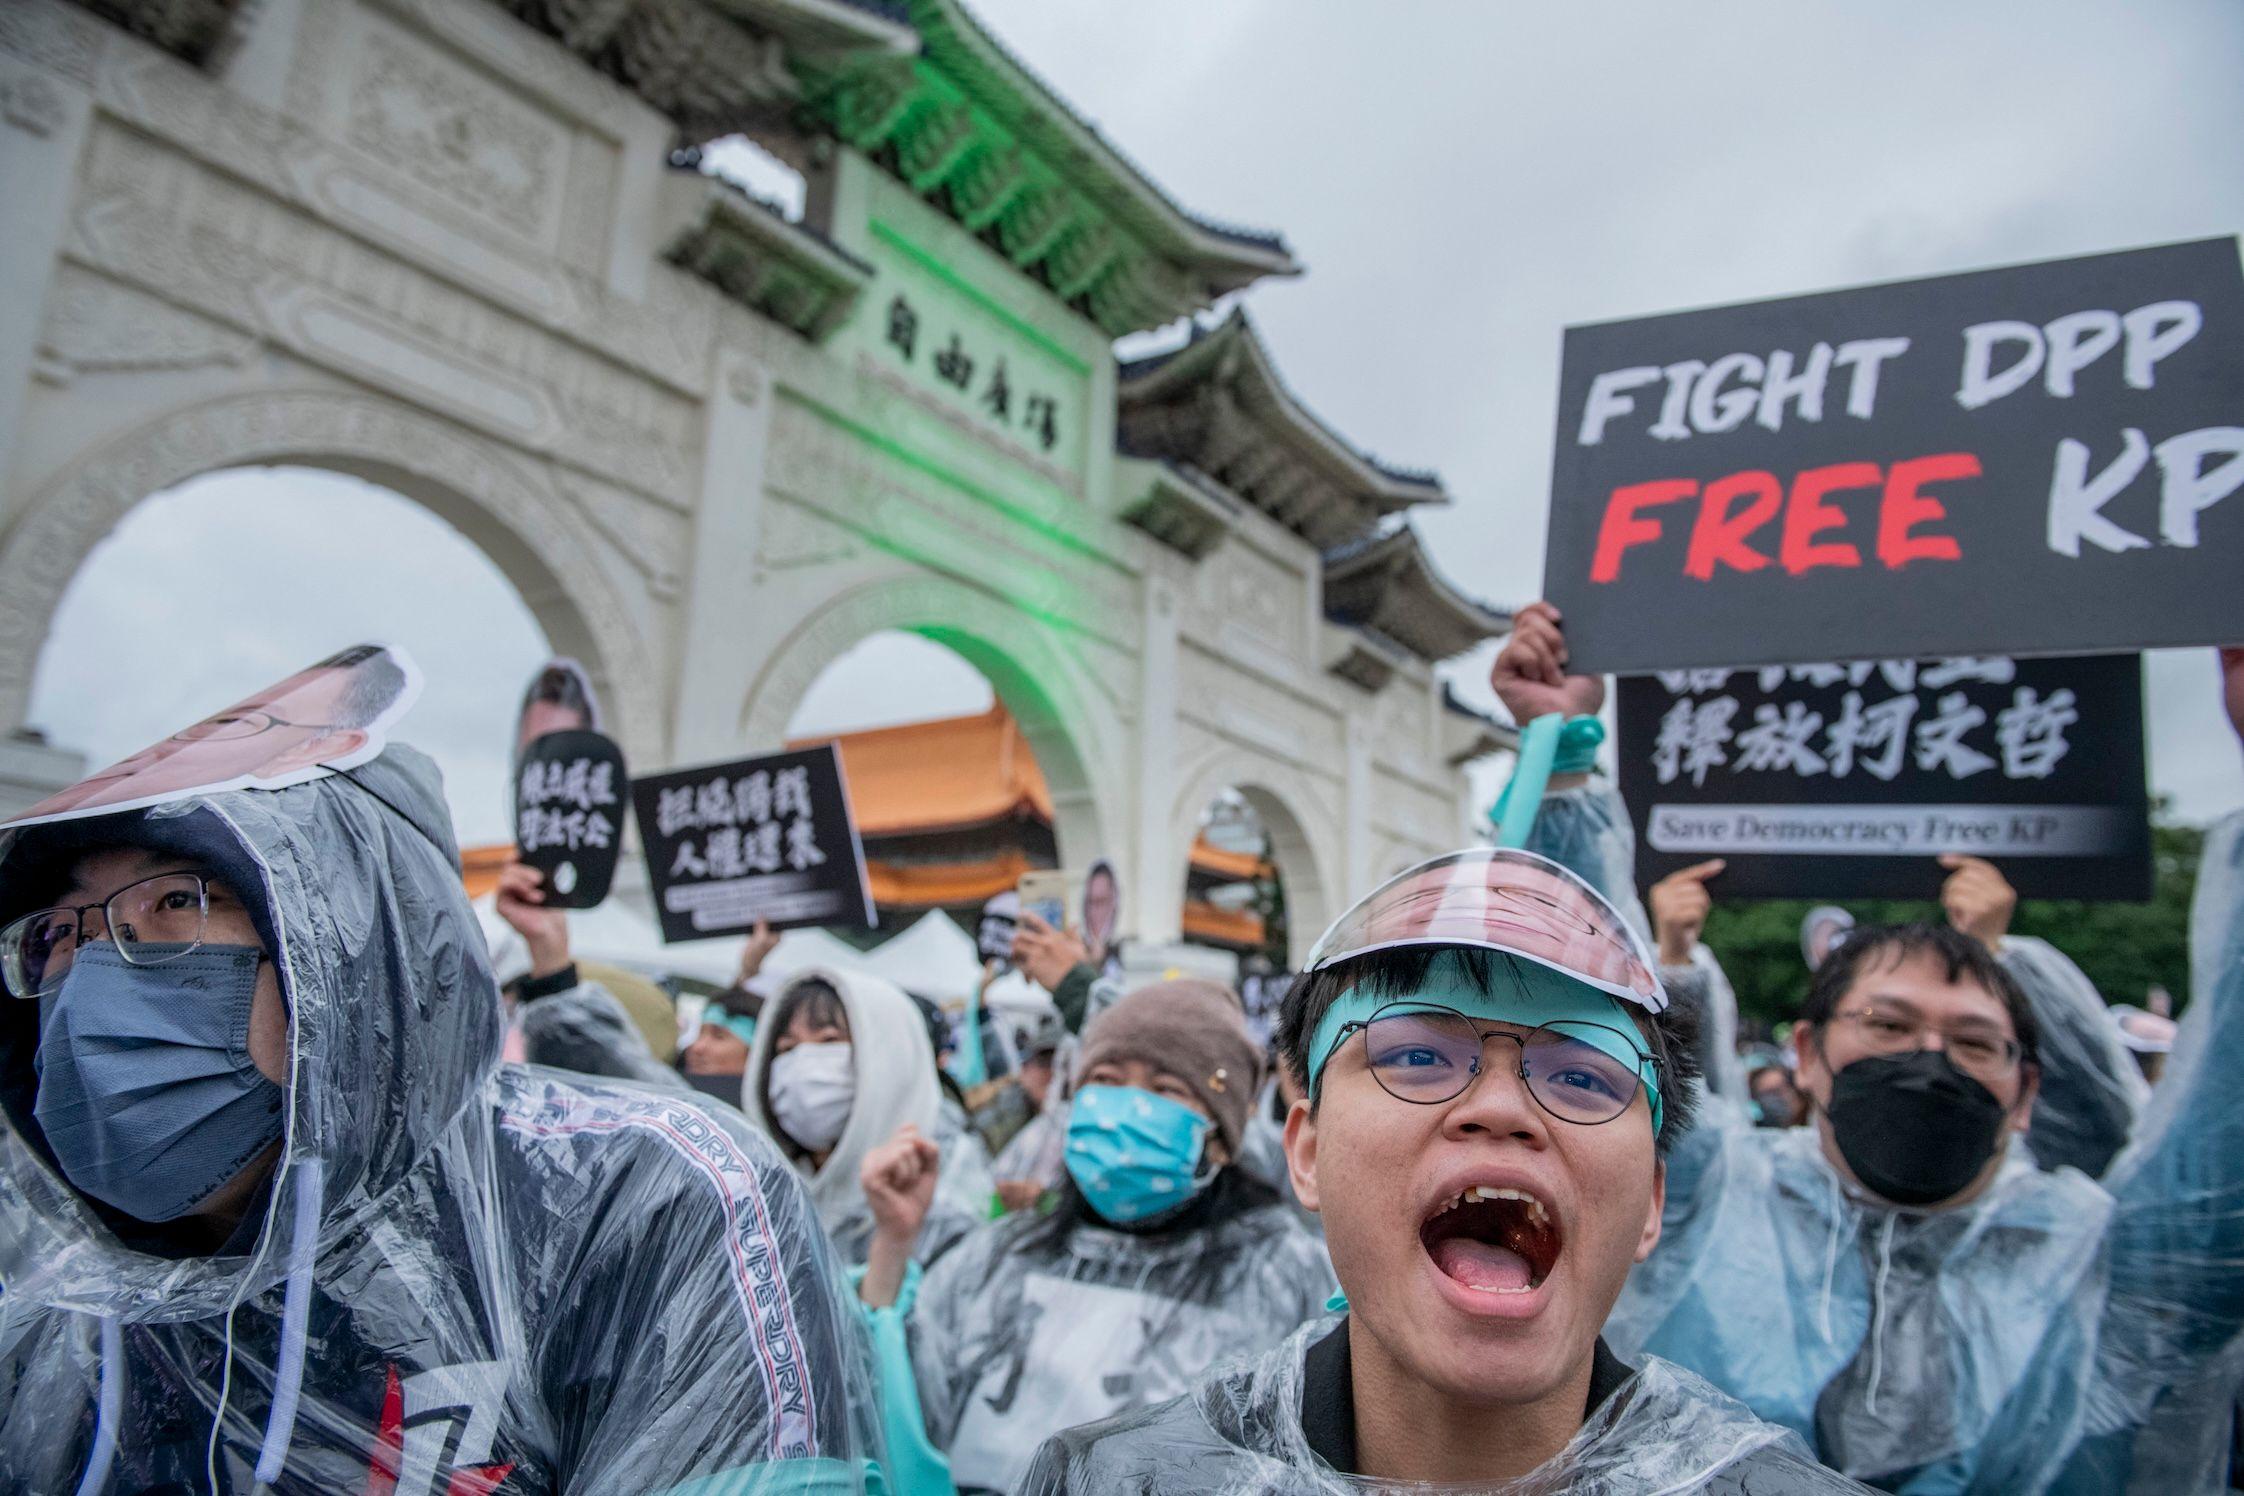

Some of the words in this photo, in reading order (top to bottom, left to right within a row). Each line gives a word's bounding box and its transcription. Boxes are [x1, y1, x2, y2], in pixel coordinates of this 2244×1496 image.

[1577, 336, 1911, 446] FIGHT
[1955, 299, 2202, 412] DPP
[1589, 453, 1984, 584] FREE
[2046, 426, 2244, 558] KP
[1653, 685, 2080, 788] 釋放柯文哲
[1660, 812, 1728, 841] Save
[1734, 810, 1913, 847] Democracy
[1923, 812, 1998, 842] Free
[735, 1196, 806, 1416] SUPERDRY
